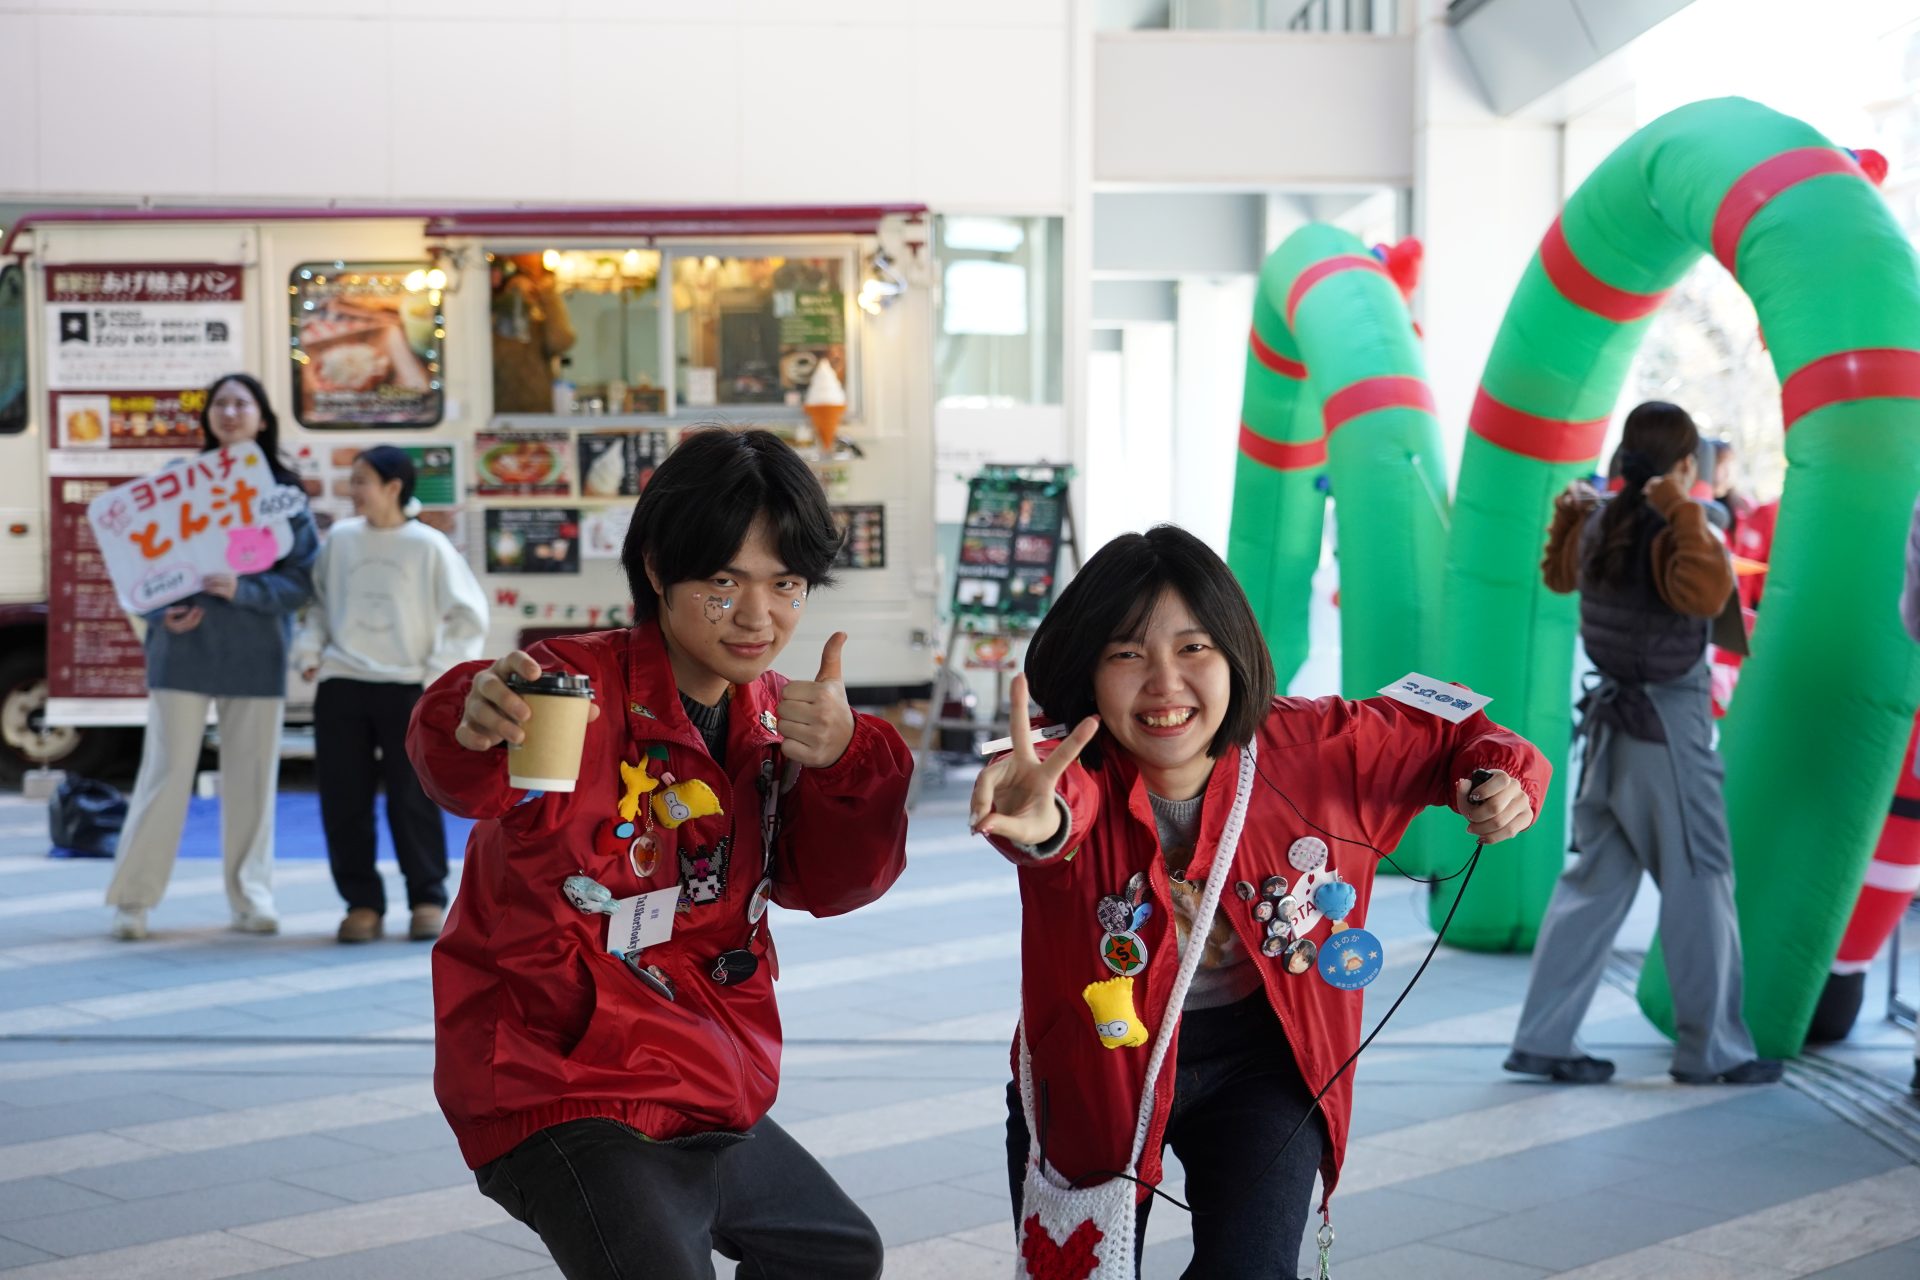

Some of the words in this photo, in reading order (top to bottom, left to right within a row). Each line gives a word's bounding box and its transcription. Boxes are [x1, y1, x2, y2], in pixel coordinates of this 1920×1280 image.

[129, 480, 257, 560] とん汁
[1332, 934, 1359, 950] ほのか
[1116, 946, 1130, 961] S
